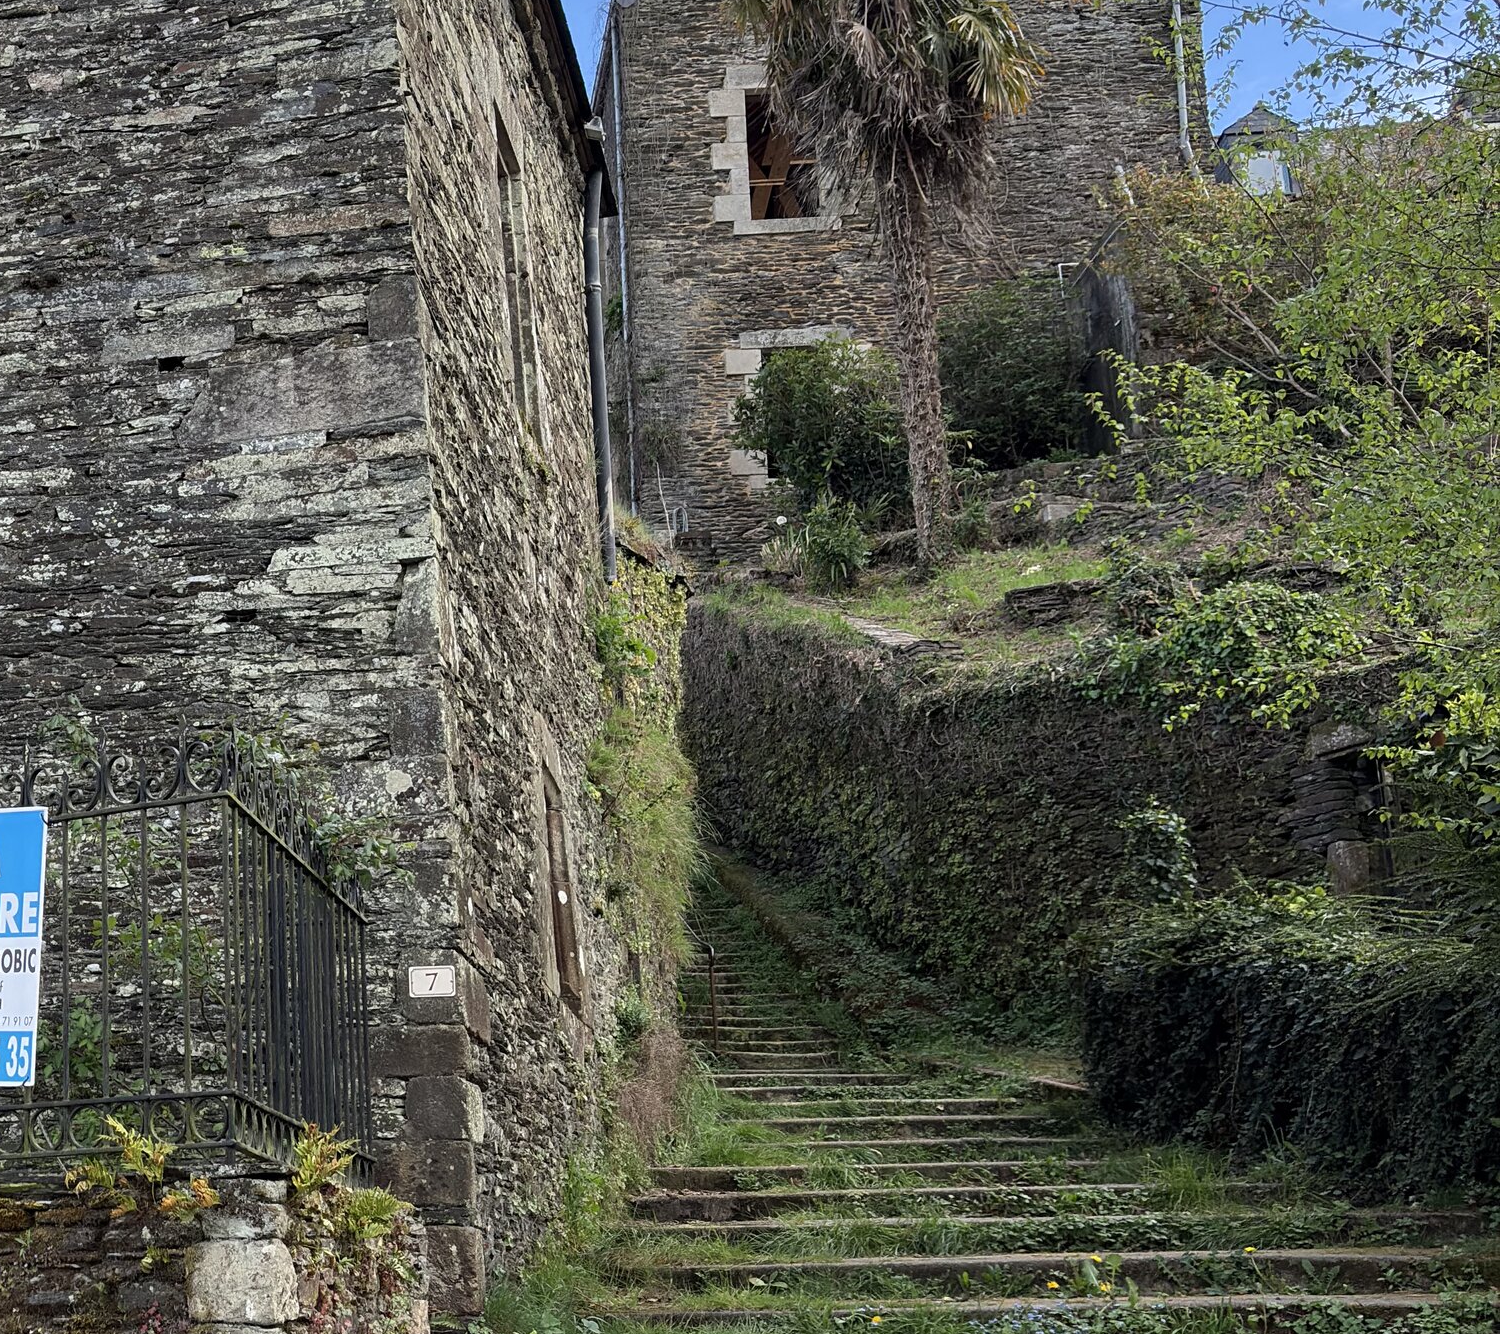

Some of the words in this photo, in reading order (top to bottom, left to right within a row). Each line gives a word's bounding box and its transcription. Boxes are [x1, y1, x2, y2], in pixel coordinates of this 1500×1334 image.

[425, 972, 439, 991] 7
[2, 1016, 11, 1026] 71
[13, 1016, 21, 1026] 91
[23, 1016, 34, 1026] 07
[5, 1035, 30, 1078] 35
